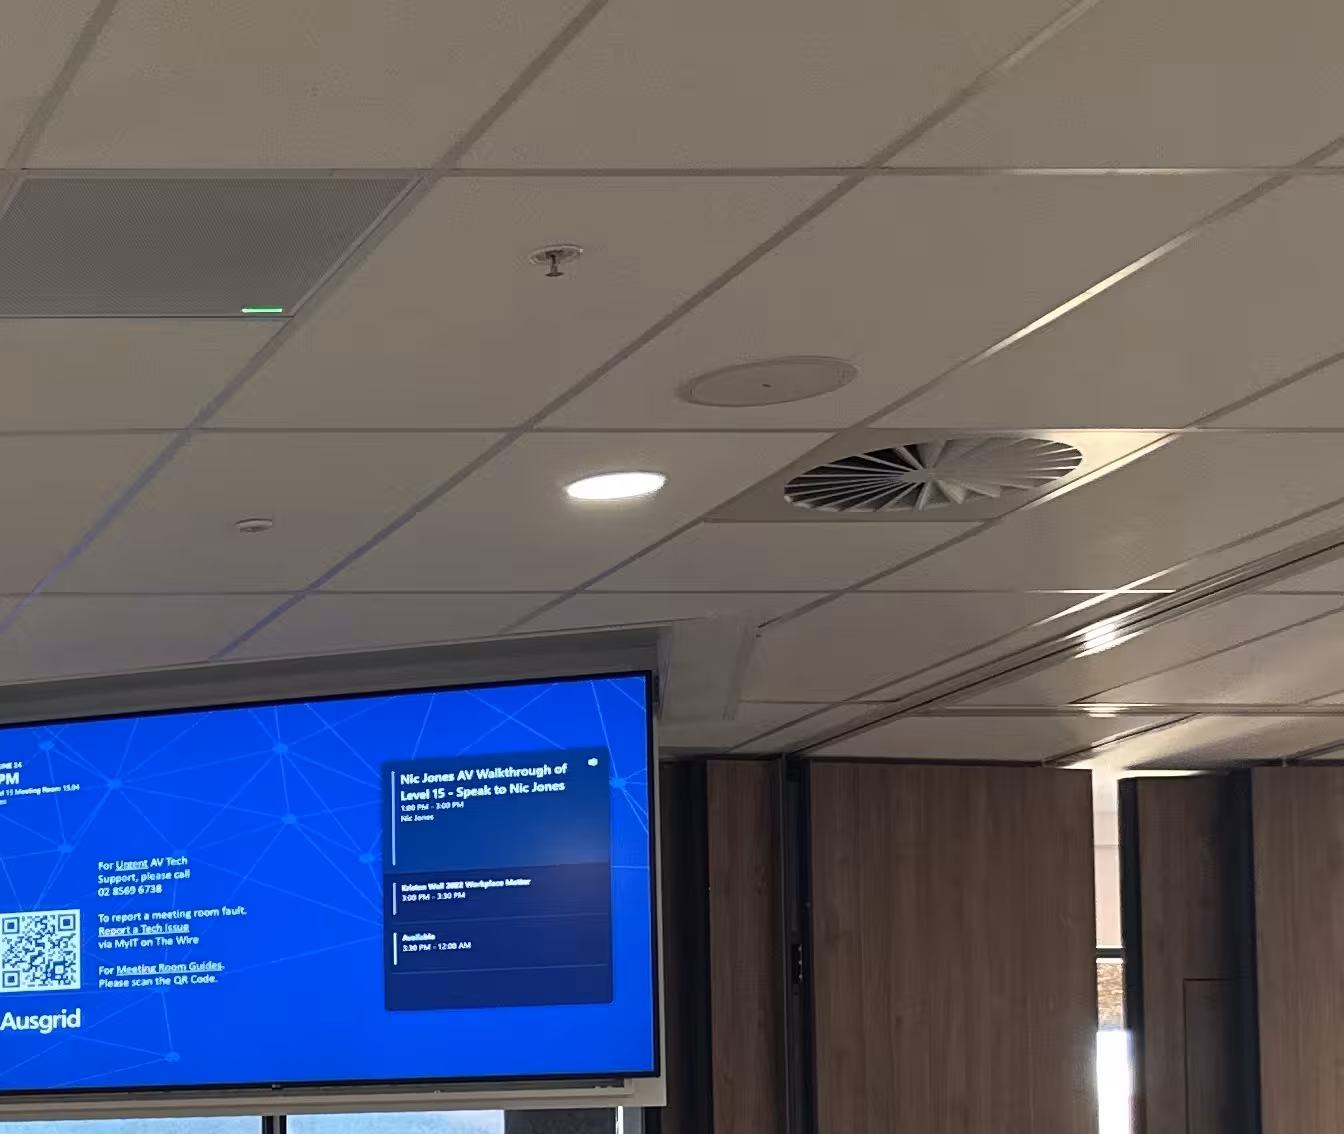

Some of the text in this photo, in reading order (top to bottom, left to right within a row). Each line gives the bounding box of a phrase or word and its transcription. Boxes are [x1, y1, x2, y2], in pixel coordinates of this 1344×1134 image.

[400, 763, 568, 785] Nic Jones AV Walkthrough of
[400, 789, 430, 801] Level
[432, 788, 445, 799] 15
[456, 785, 491, 799] Speak
[494, 785, 507, 795] to
[510, 783, 529, 794] Nic
[532, 782, 565, 793] Jones
[98, 856, 188, 872] For Urgent AV Tech
[98, 869, 191, 885] Support, please call
[97, 884, 162, 897] 02 8569 6738
[98, 913, 109, 923] To
[112, 913, 141, 923] report
[152, 909, 192, 920] meeting
[194, 908, 219, 917] room
[98, 927, 131, 938] Report
[141, 924, 162, 935] Tech
[165, 923, 190, 934] Issue
[98, 936, 199, 949] via MyIT on The Wire
[98, 966, 113, 976] For
[116, 964, 156, 976] Meeting
[159, 963, 187, 974] Room
[99, 974, 218, 988] Please scan the QR Code.
[0, 1008, 81, 1034] Ausgrid
